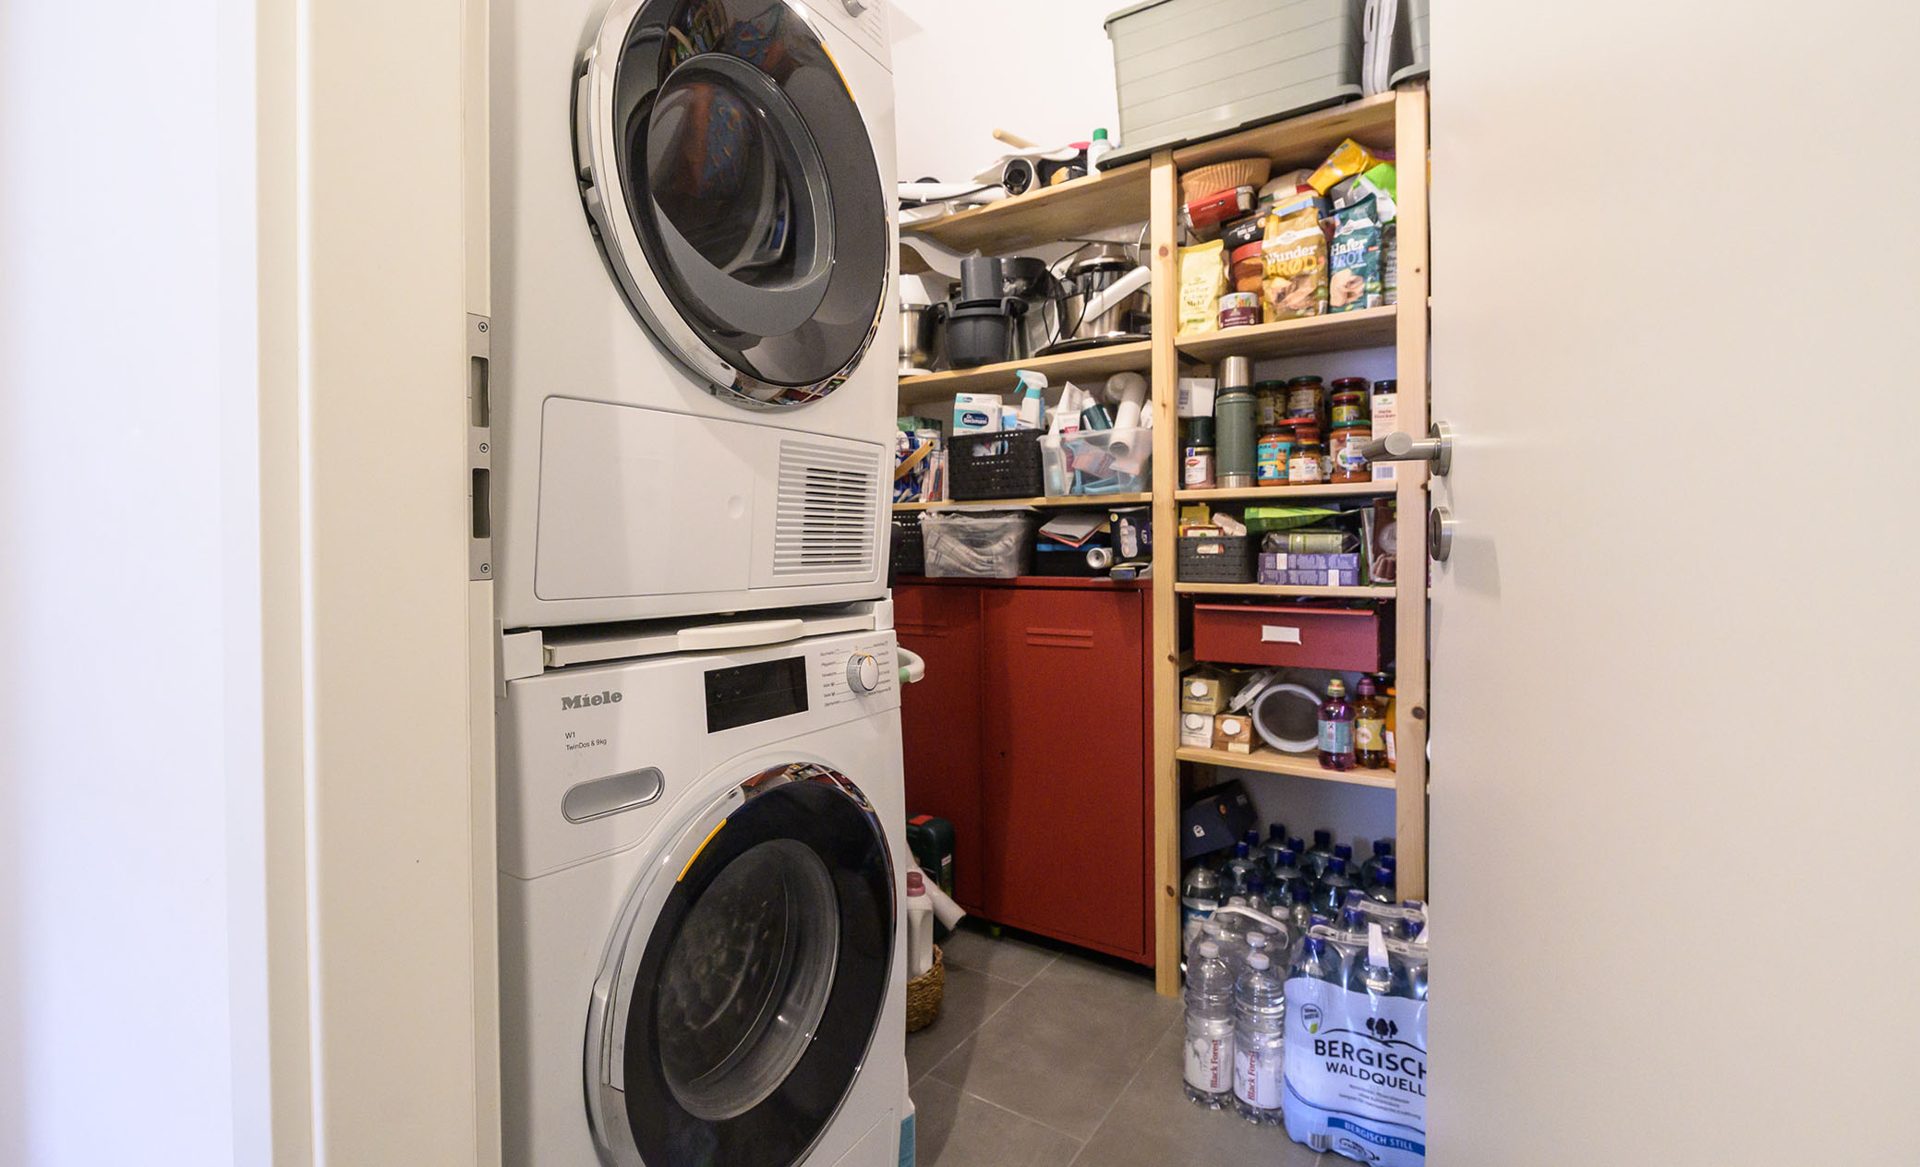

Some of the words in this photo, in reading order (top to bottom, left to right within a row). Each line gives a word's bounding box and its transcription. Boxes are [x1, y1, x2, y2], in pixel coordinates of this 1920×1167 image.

[1265, 245, 1318, 265] Wunder
[1330, 238, 1368, 256] Hafer
[1267, 255, 1317, 276] BRØD
[1330, 249, 1365, 269] BROT
[561, 691, 622, 710] Miele
[565, 732, 576, 740] W1
[566, 742, 590, 751] TwinDos
[1210, 1066, 1218, 1088] Black
[1326, 1062, 1426, 1097] WALDQUELL
[1247, 1079, 1256, 1101] Black
[1344, 1121, 1387, 1146] BERGISCH
[1390, 1138, 1413, 1150] STILL
